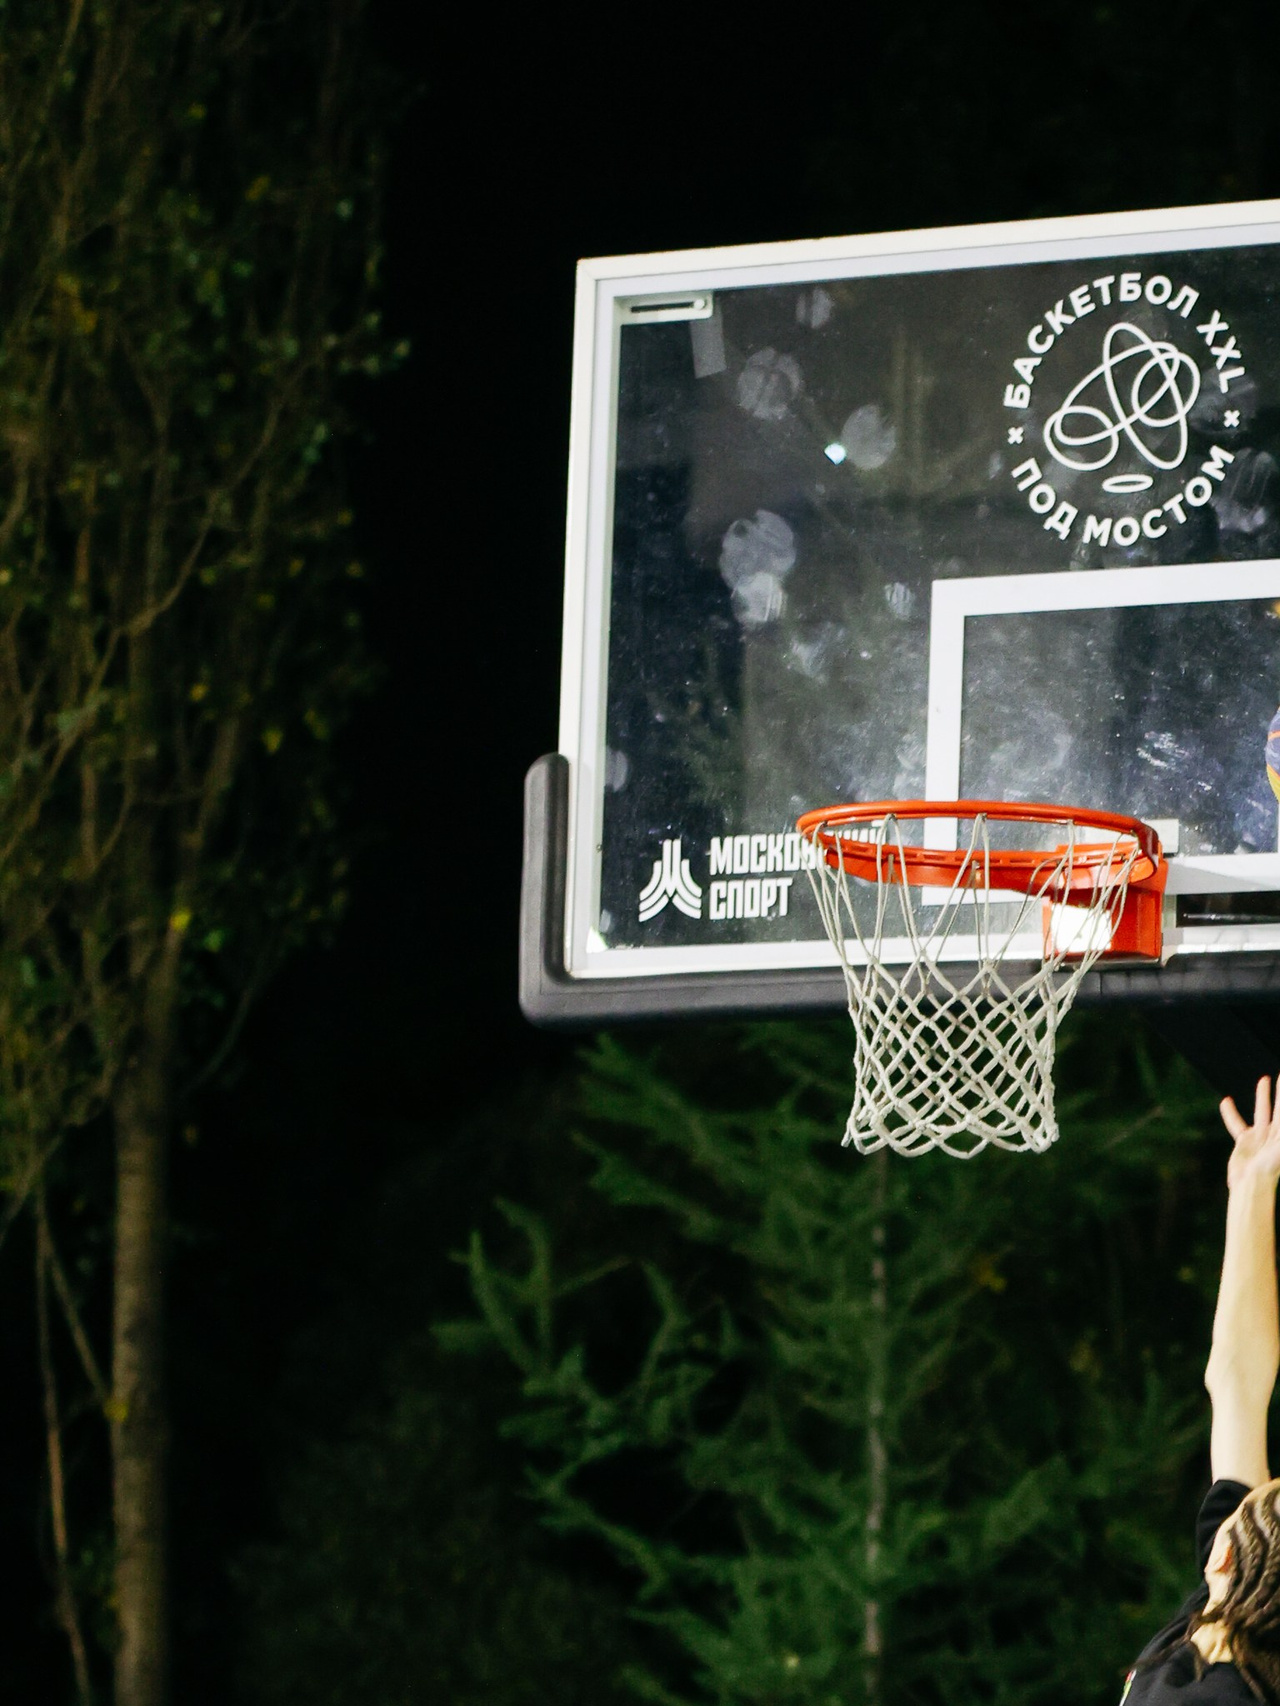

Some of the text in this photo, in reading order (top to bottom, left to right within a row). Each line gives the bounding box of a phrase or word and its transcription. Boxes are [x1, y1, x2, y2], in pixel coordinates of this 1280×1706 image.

[1003, 272, 1200, 409] БАСКЕТБОЛ
[1011, 444, 1235, 547] ПОД МОСТОМ
[709, 876, 794, 920] СПОРТ
